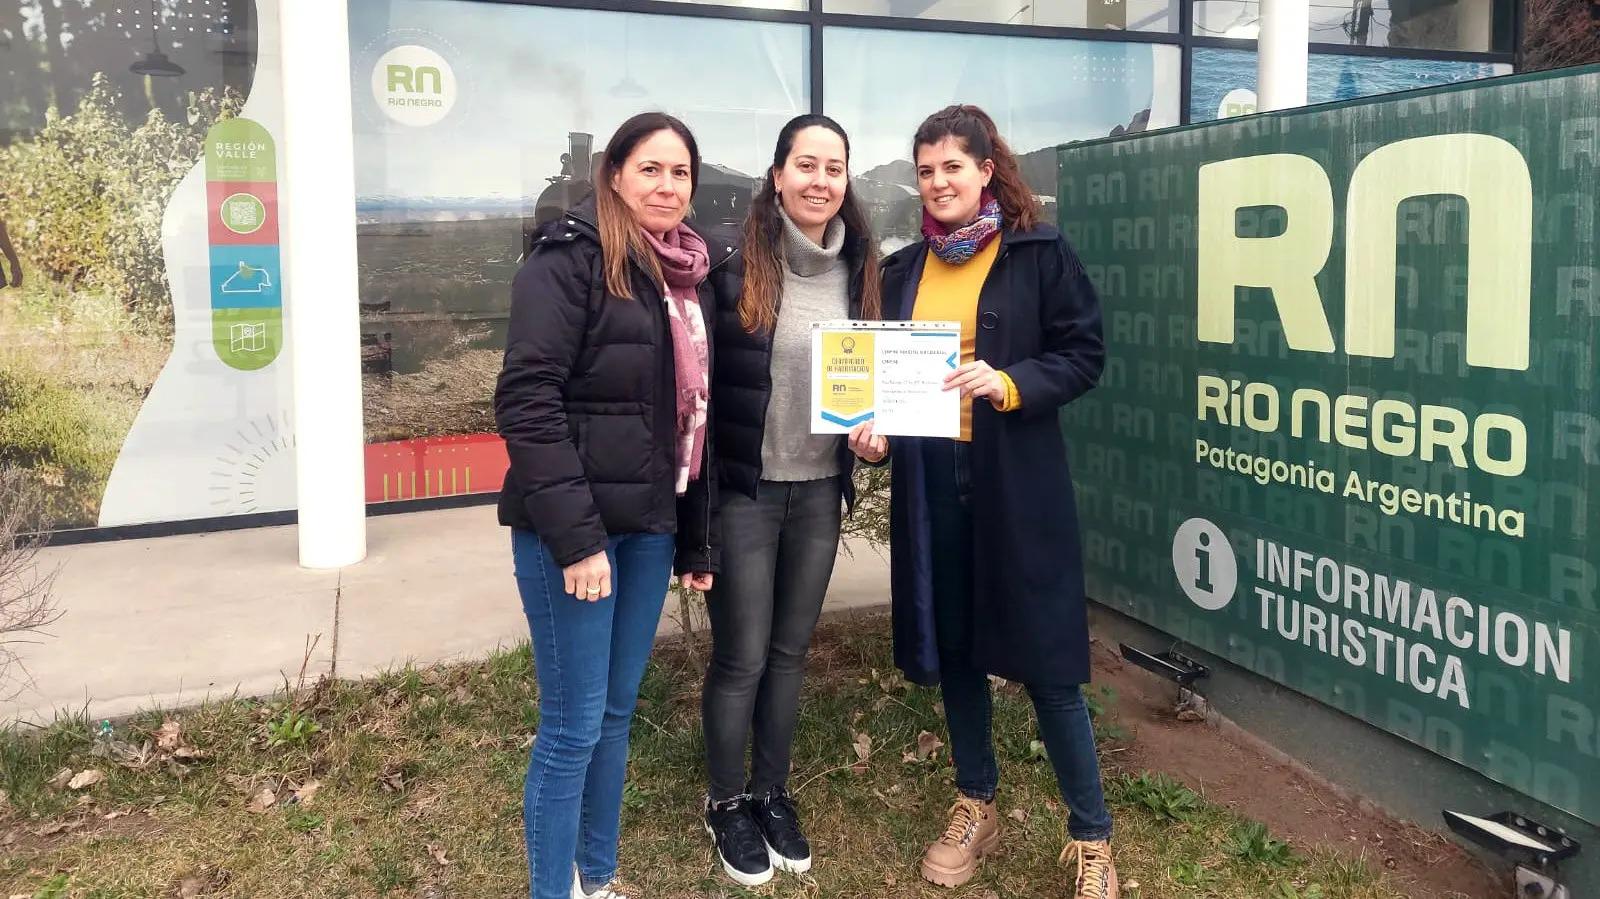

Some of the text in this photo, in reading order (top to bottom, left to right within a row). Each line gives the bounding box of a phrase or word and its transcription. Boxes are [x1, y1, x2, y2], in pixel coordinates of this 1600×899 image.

[387, 65, 442, 94] RN
[215, 151, 257, 159] VALLE
[1197, 133, 1534, 370] RN
[1291, 388, 1527, 477] NEGRO
[1195, 439, 1526, 538] Patagonia Argentina
[1254, 586, 1470, 710] TURISTICA
[1256, 538, 1571, 683] INFORMACION
